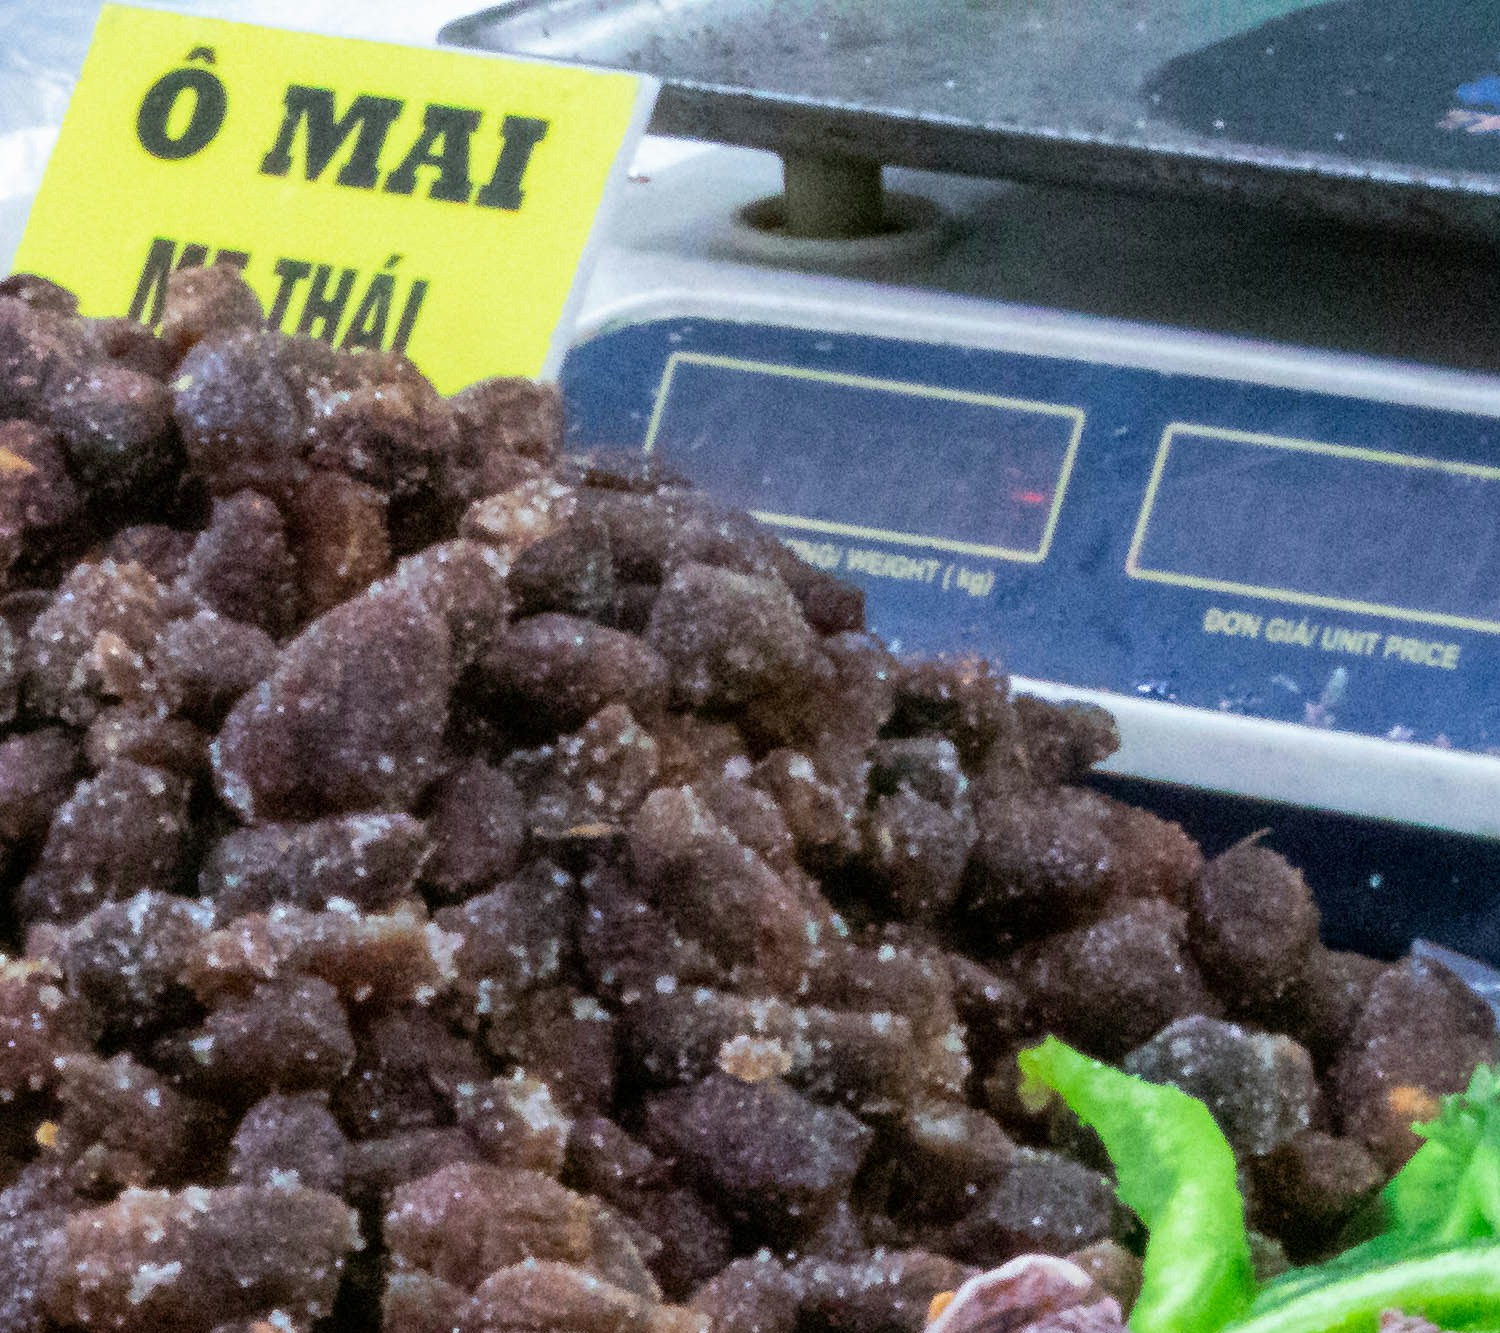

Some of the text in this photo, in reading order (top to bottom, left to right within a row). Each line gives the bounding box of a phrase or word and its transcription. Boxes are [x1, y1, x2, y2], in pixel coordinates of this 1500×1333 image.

[136, 46, 550, 211] Ô MAI
[266, 253, 430, 353] THÁI
[846, 548, 942, 584] WEIGHT
[1320, 626, 1382, 657] UNIT
[1383, 634, 1462, 671] PRICE
